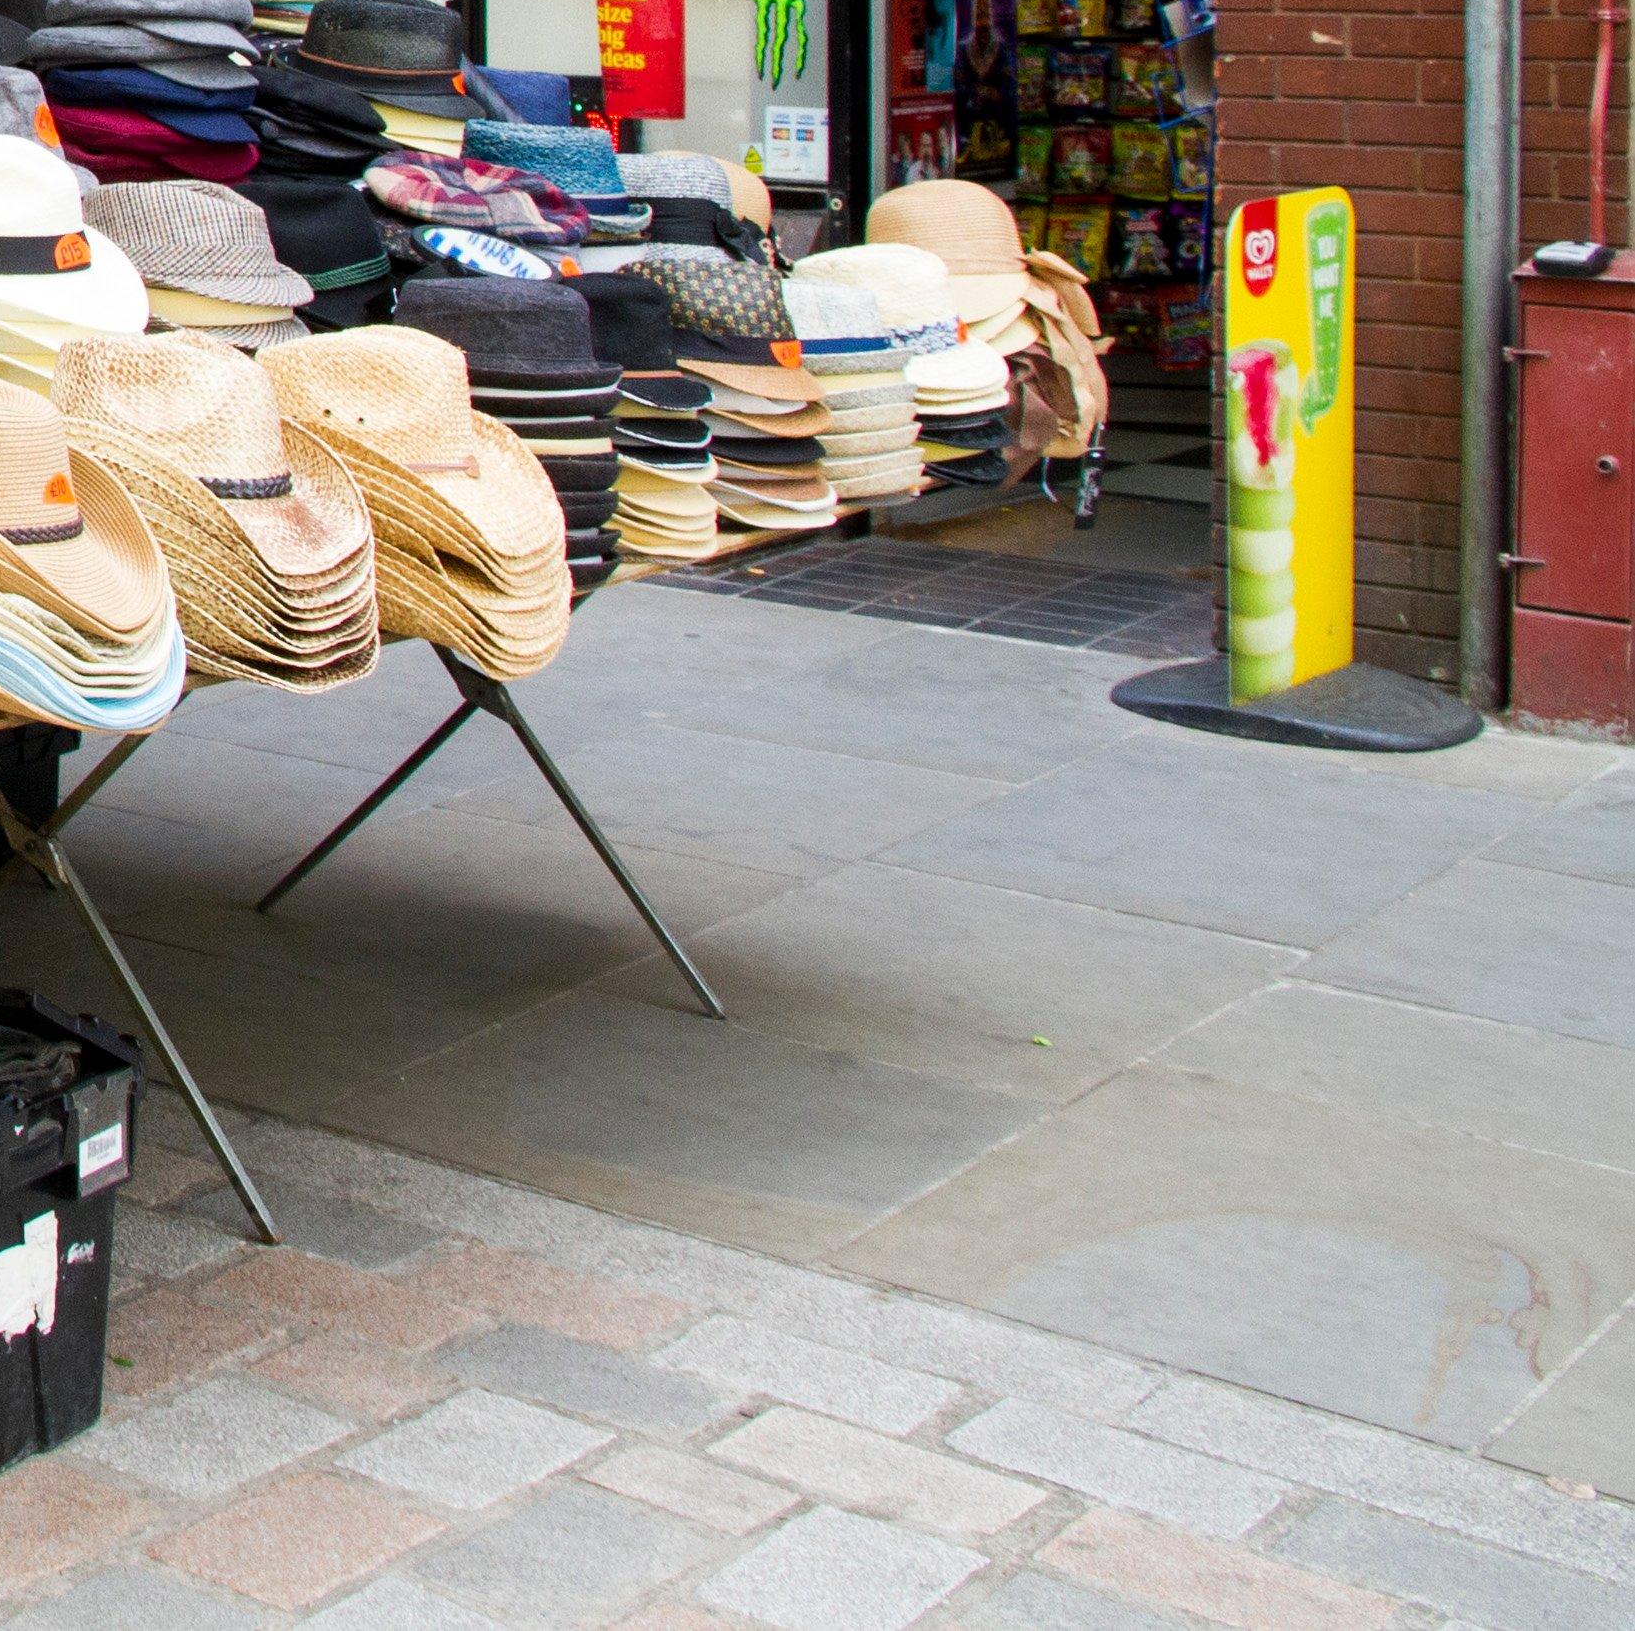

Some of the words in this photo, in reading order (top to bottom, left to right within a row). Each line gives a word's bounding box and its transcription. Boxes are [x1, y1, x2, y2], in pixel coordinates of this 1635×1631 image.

[597, 1, 632, 23] size
[60, 240, 83, 265] £15
[50, 478, 66, 498] £10
